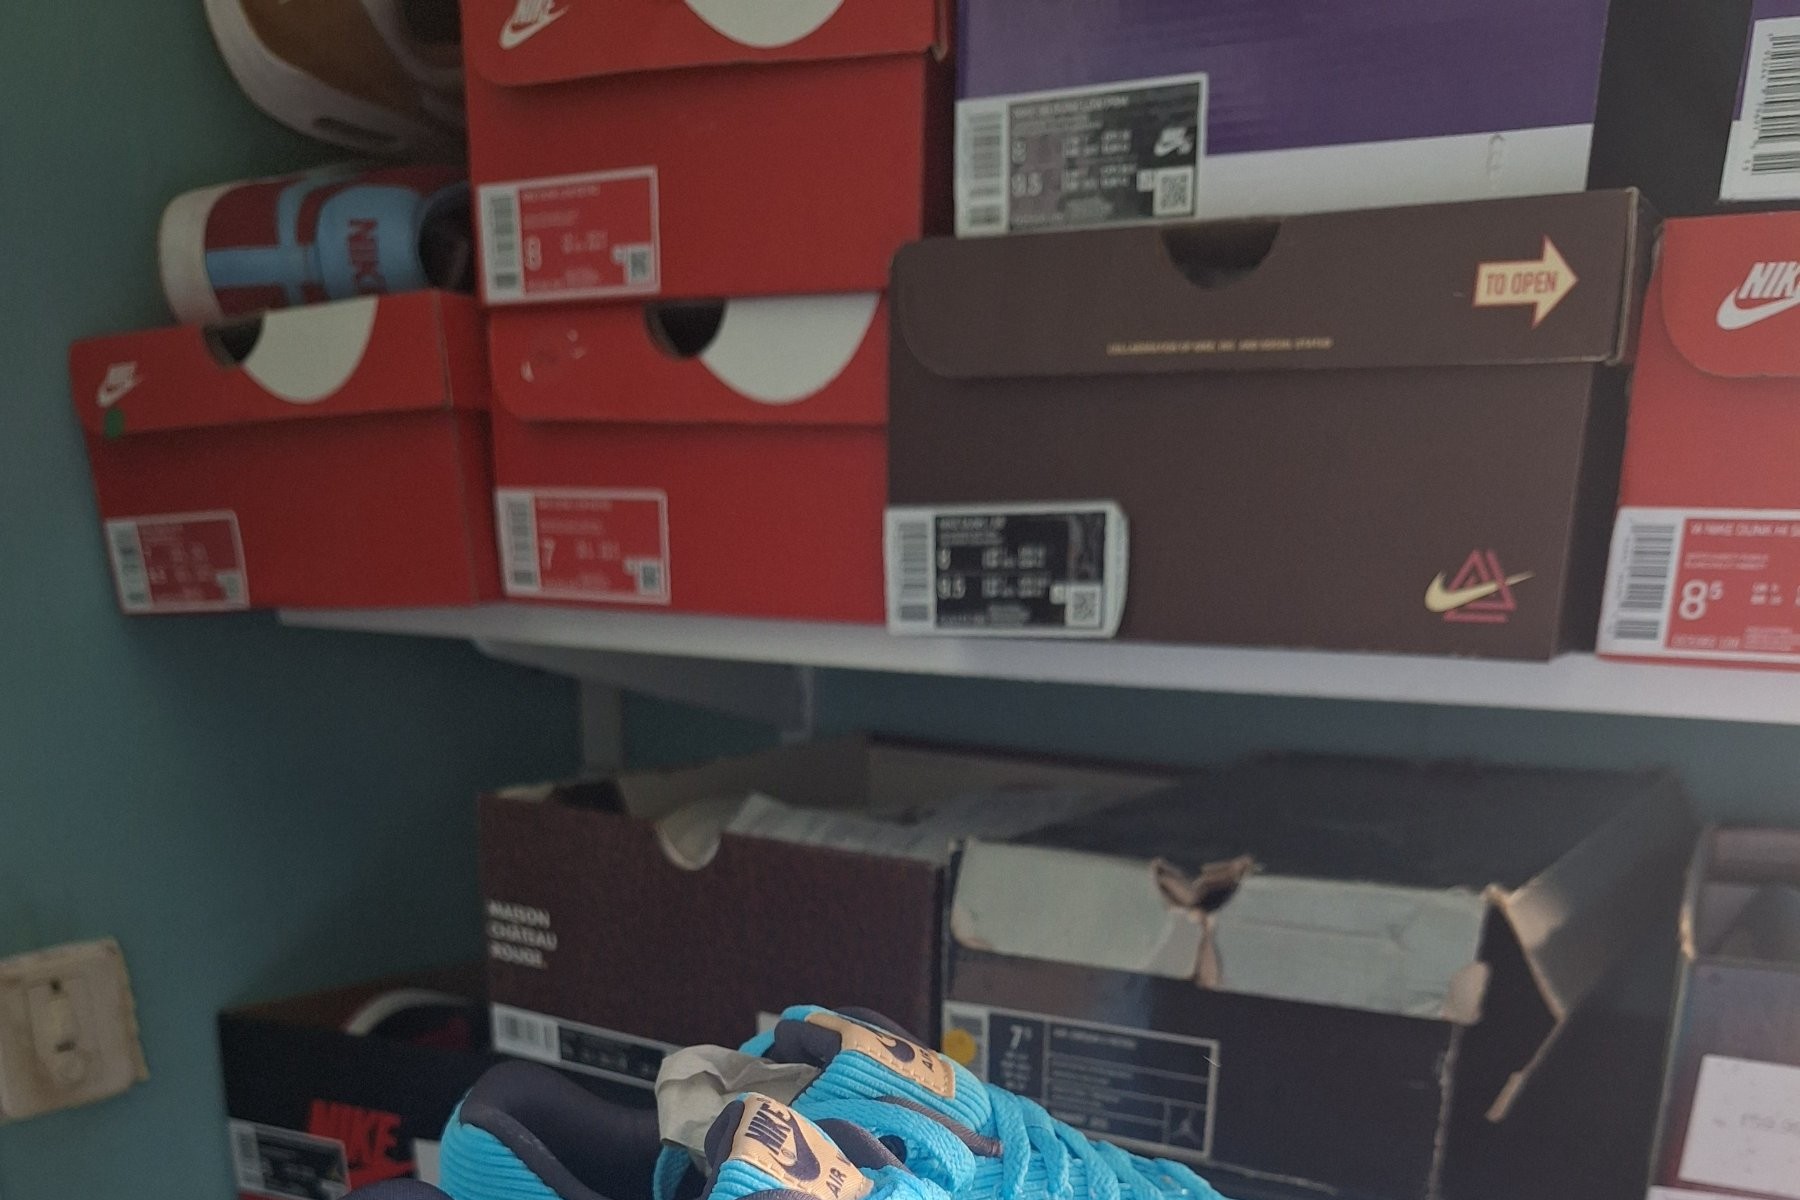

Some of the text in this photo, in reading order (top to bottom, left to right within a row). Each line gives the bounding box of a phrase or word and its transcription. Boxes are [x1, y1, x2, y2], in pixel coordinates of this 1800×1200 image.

[1486, 270, 1558, 296] TO OPEN
[1736, 261, 1800, 299] NIK
[745, 1102, 791, 1156] NIKE
[826, 1167, 847, 1199] AIR
